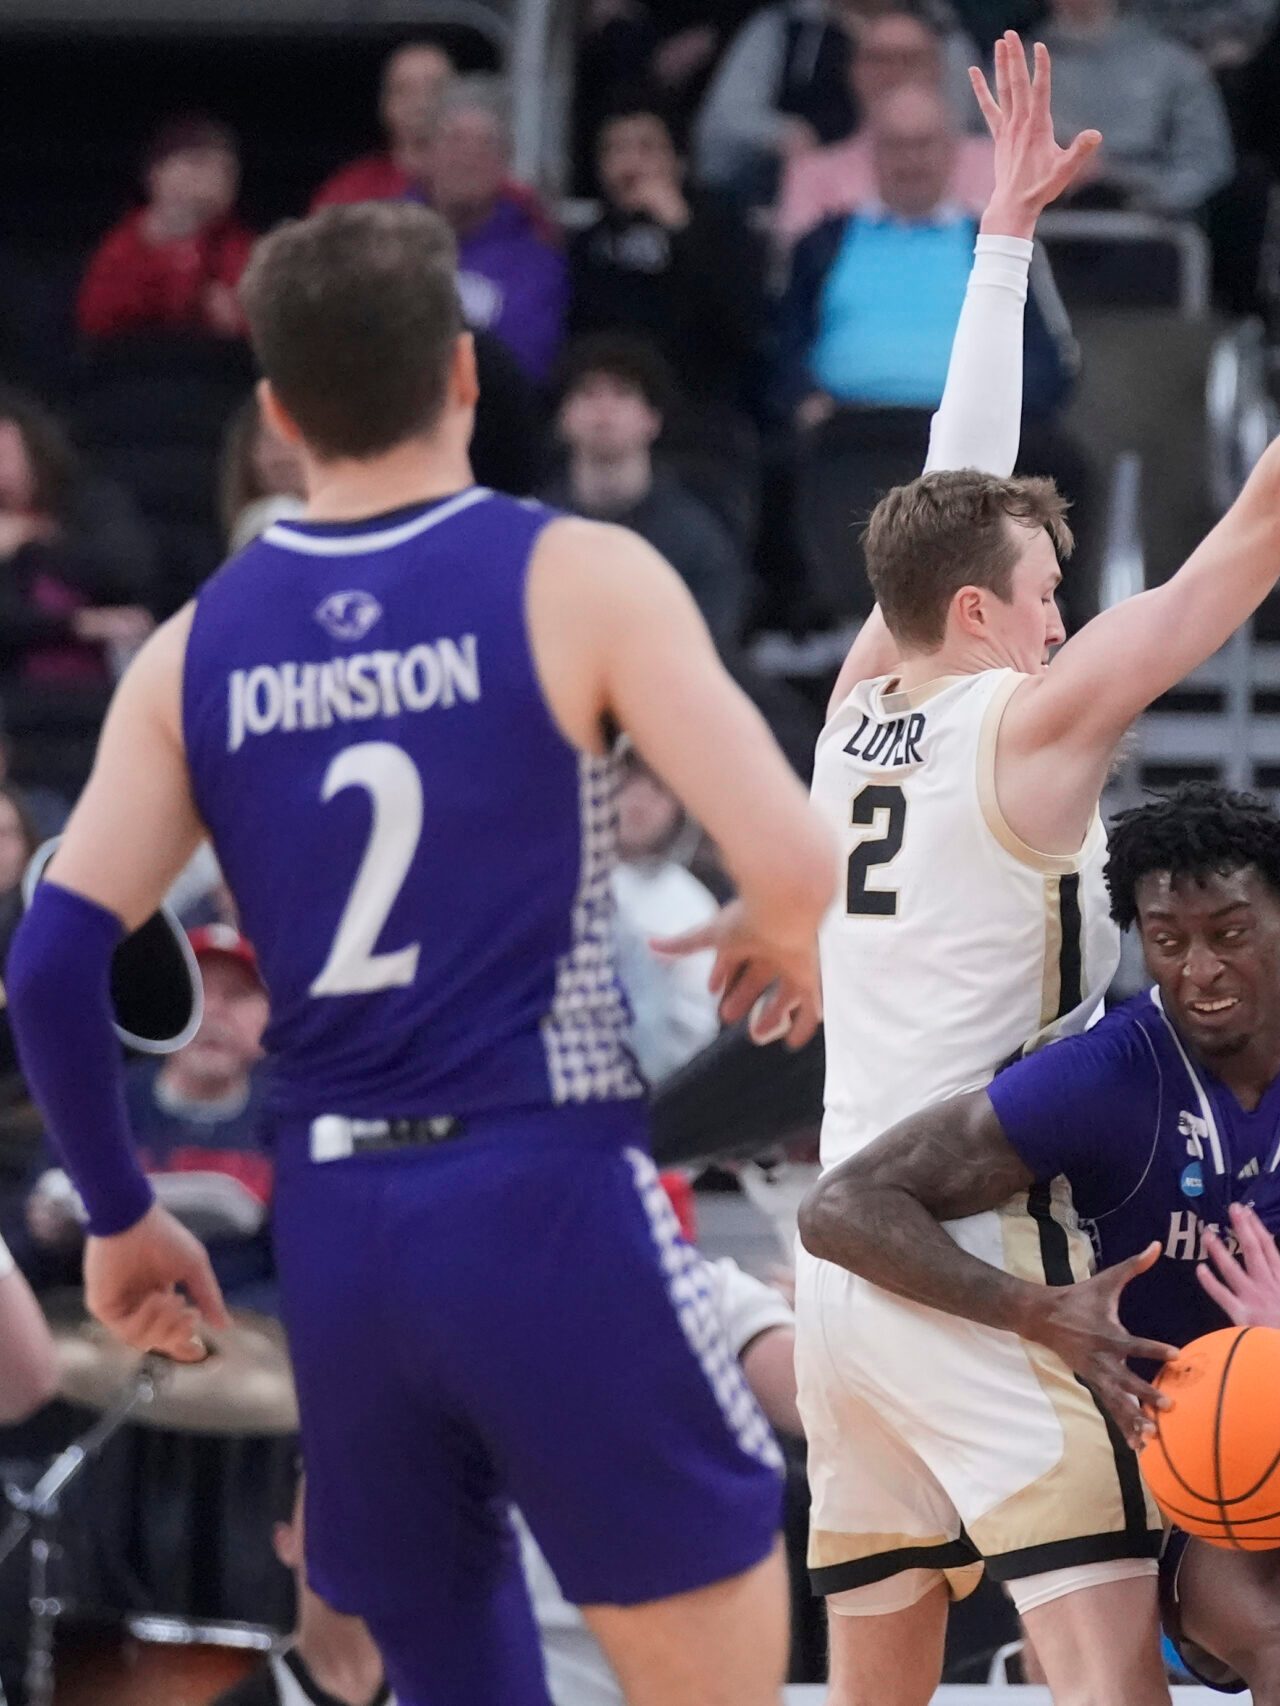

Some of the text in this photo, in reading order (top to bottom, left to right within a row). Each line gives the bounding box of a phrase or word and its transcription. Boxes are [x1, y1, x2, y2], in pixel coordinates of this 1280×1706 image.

[227, 632, 481, 753] JOHNSTON
[309, 740, 424, 998] 2
[847, 784, 907, 915] 2
